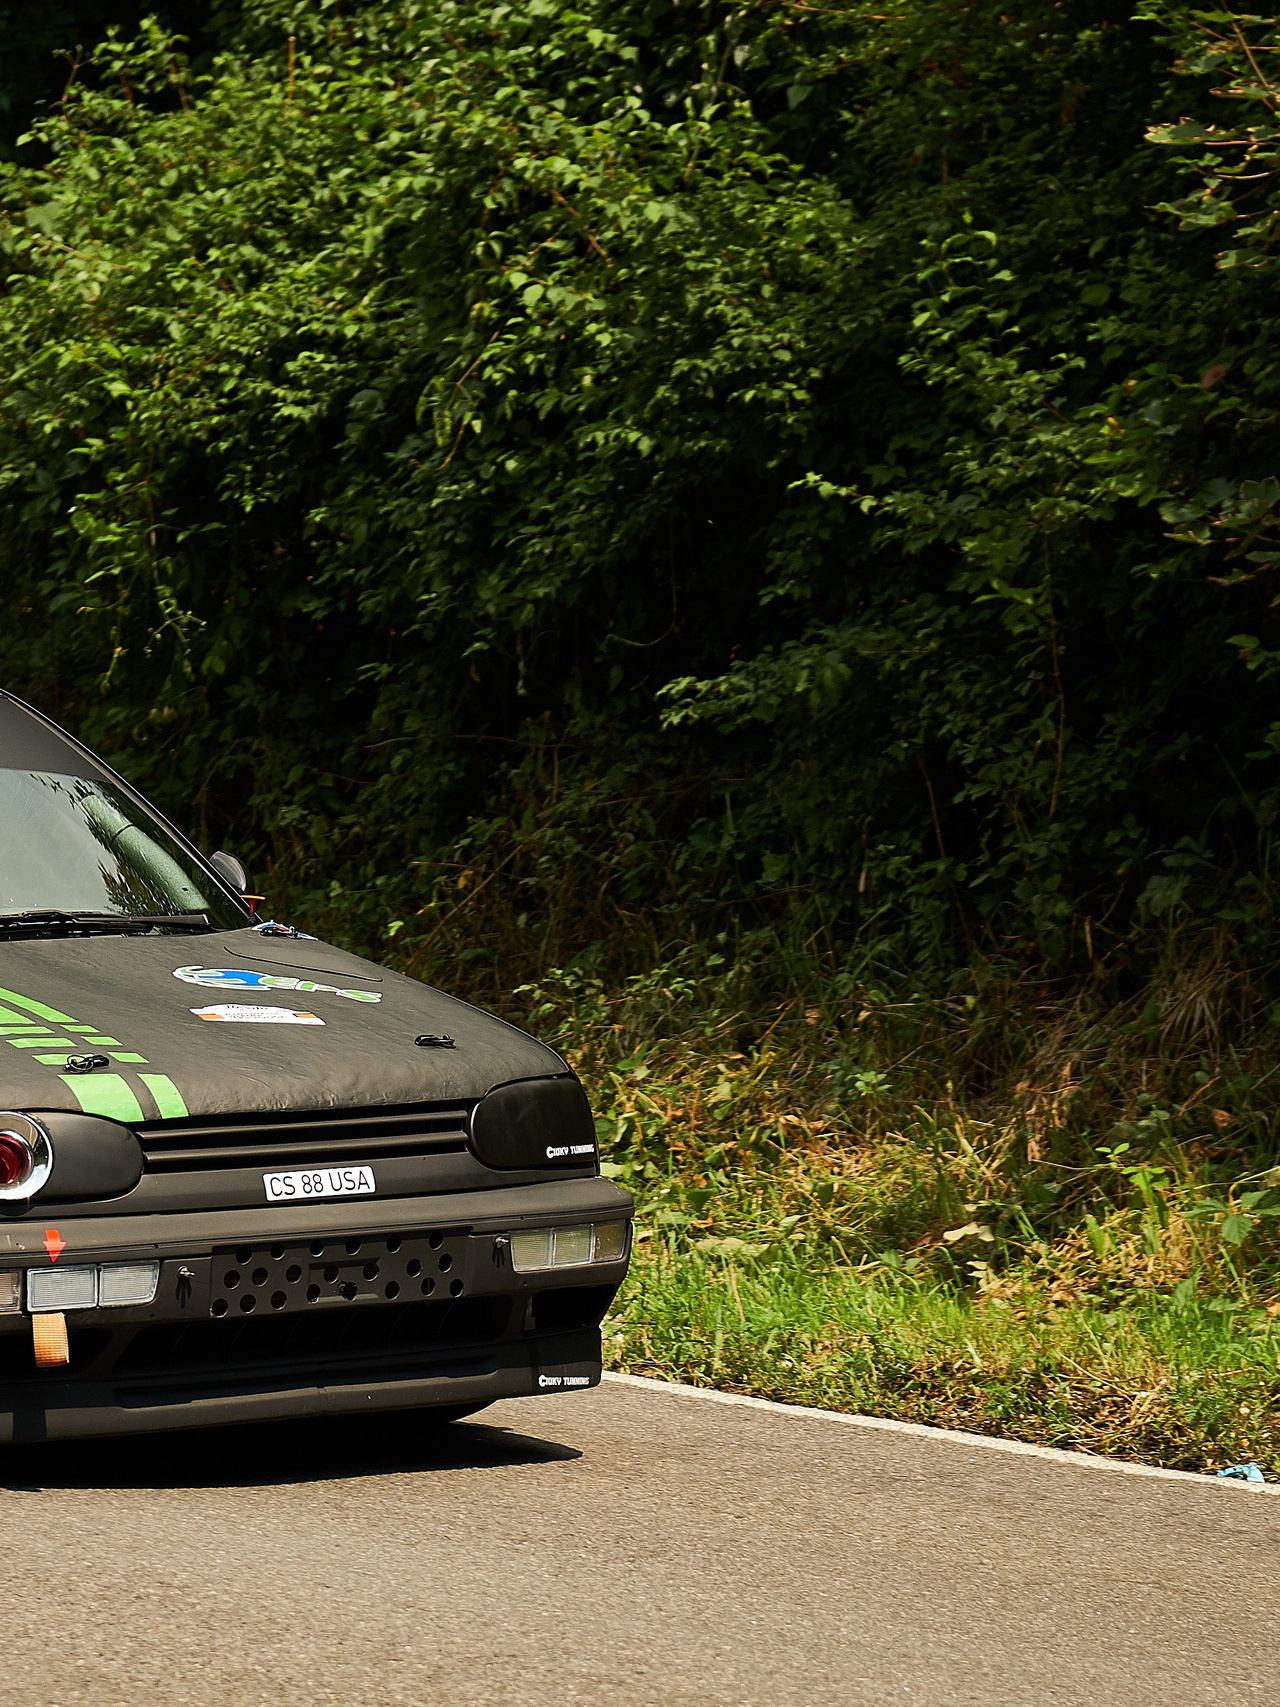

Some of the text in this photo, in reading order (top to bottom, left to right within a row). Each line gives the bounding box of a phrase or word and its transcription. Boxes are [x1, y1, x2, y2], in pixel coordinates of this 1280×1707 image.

[270, 1170, 371, 1197] CS 88 USA
